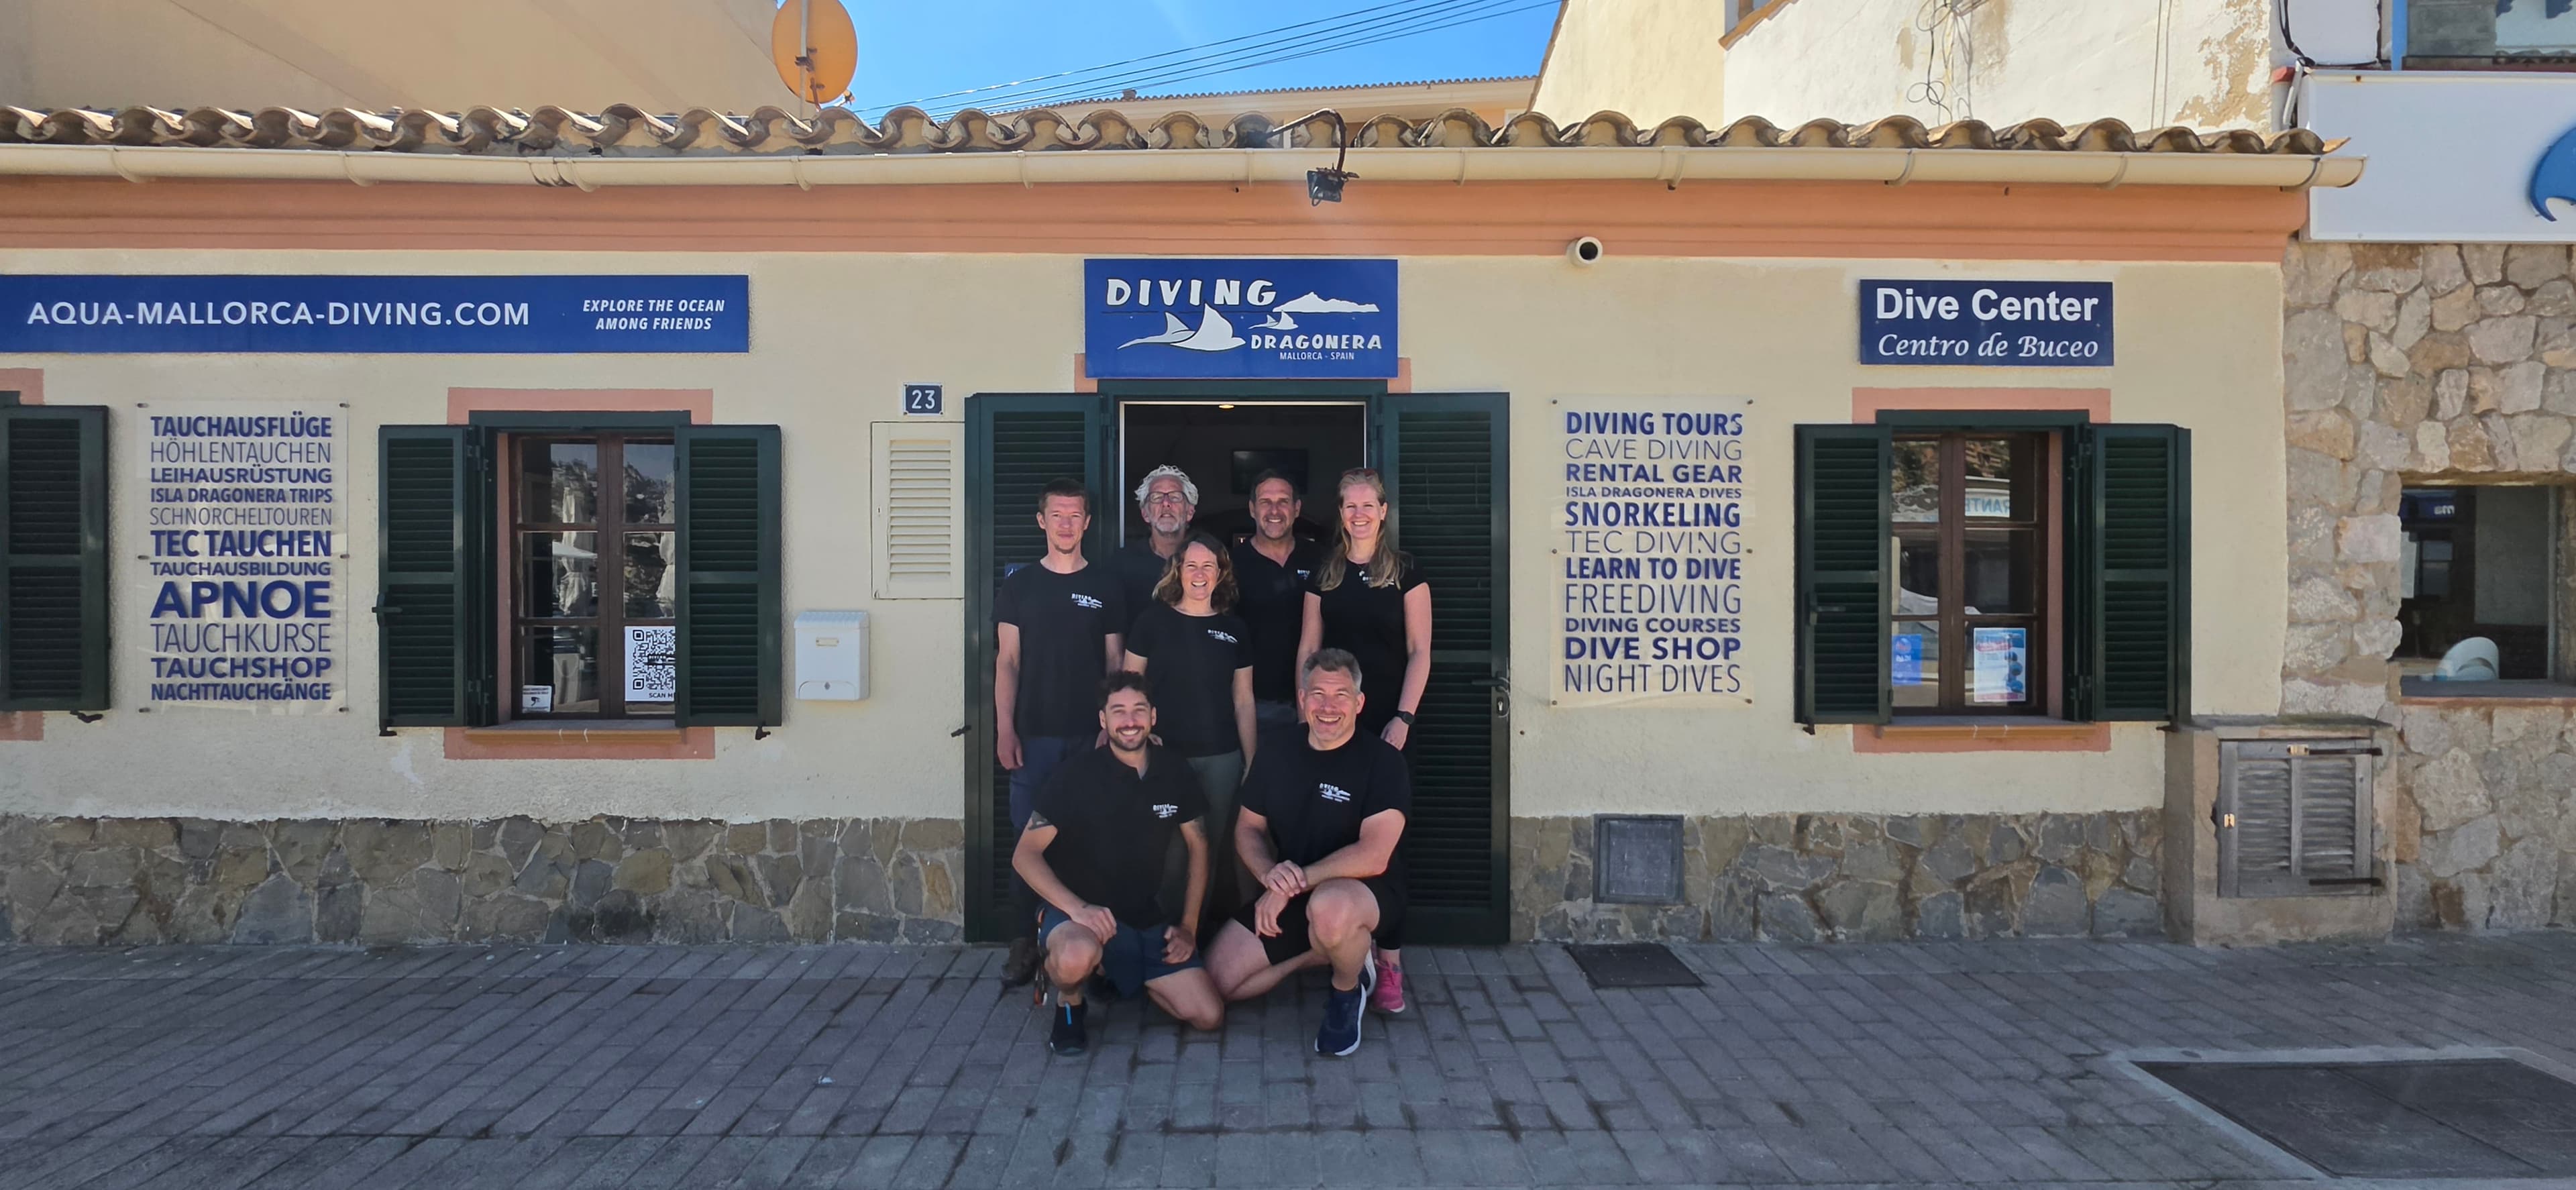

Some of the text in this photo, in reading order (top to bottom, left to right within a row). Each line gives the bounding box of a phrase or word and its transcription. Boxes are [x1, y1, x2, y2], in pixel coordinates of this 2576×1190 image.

[1107, 278, 1277, 305] DIVING
[28, 302, 529, 326] AQUA-MALLORCA-DIVING.COM
[583, 300, 725, 312] EXPLORE THE OCEAN
[1878, 288, 2098, 321] Dive Center
[596, 318, 712, 331] AMONG FRIENDS
[1252, 334, 1383, 350] DRAGONERA
[1878, 332, 2098, 358] Centro de Buceo
[1280, 352, 1322, 361] MALLORCA
[1330, 352, 1355, 361] SPAIN
[911, 389, 936, 409] 23
[151, 411, 332, 437] TAUCHAUSFLÜGE
[1568, 413, 1743, 436] DIVING TOURS
[151, 438, 331, 464] HÖHLENTAUCHEN
[1567, 439, 1741, 461] CAVE DIVING
[152, 465, 332, 484] LEIHAUSRÜSTUNG
[1567, 464, 1742, 484] RENTAL GEAR
[152, 488, 333, 503] ISLA DRAGONERA TRIPS
[1568, 488, 1741, 499] ISLA DRAGONERA DIVES
[151, 508, 331, 526] SCHNORCHELTOUREN
[1566, 502, 1740, 528] SNORKELING
[151, 531, 332, 557] TEC TAUCHEN
[1567, 531, 1741, 554] TEC DIVING
[151, 563, 331, 576] TAUCHAUSBILDUNG
[1567, 558, 1741, 580] LEARN TO DIVE
[151, 581, 332, 619] APNOE
[1567, 584, 1741, 614] FREEDIVING
[1566, 618, 1741, 633] DIVING COURSES
[151, 624, 331, 653] TAUCHKURSE
[1566, 637, 1741, 660] DIVE SHOP
[152, 657, 332, 678] TAUCHSHOP
[152, 679, 331, 701] NACHTTAUCHGÄNGE
[1566, 665, 1740, 693] NIGHT DIVES
